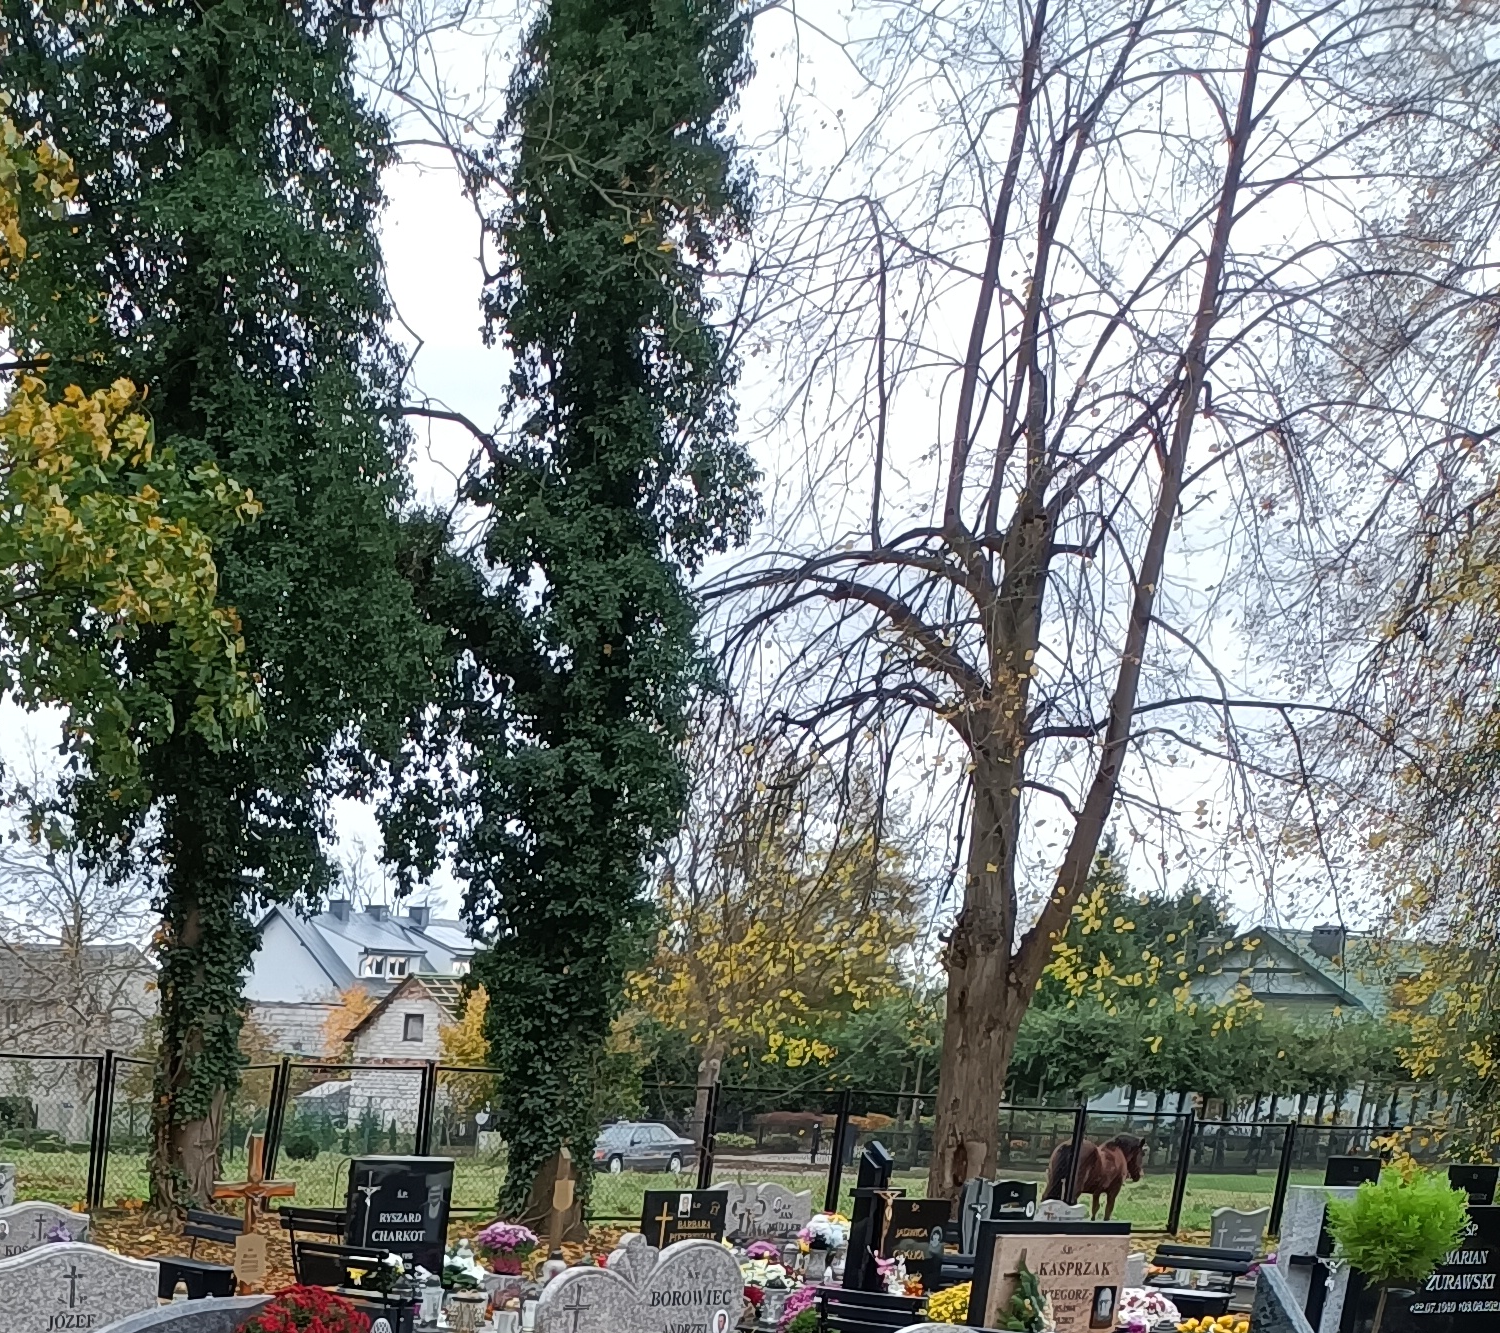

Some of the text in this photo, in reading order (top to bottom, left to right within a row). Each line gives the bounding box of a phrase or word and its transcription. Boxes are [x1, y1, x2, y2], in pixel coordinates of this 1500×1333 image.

[379, 1213, 422, 1223] RYSZARD
[371, 1230, 426, 1242] CHARKOT
[1039, 1262, 1112, 1276] KASPRZAK
[1425, 1270, 1497, 1291] ŻURAWSKI
[650, 1289, 732, 1307] BOROWIEC
[46, 1311, 97, 1332] JÓZEF
